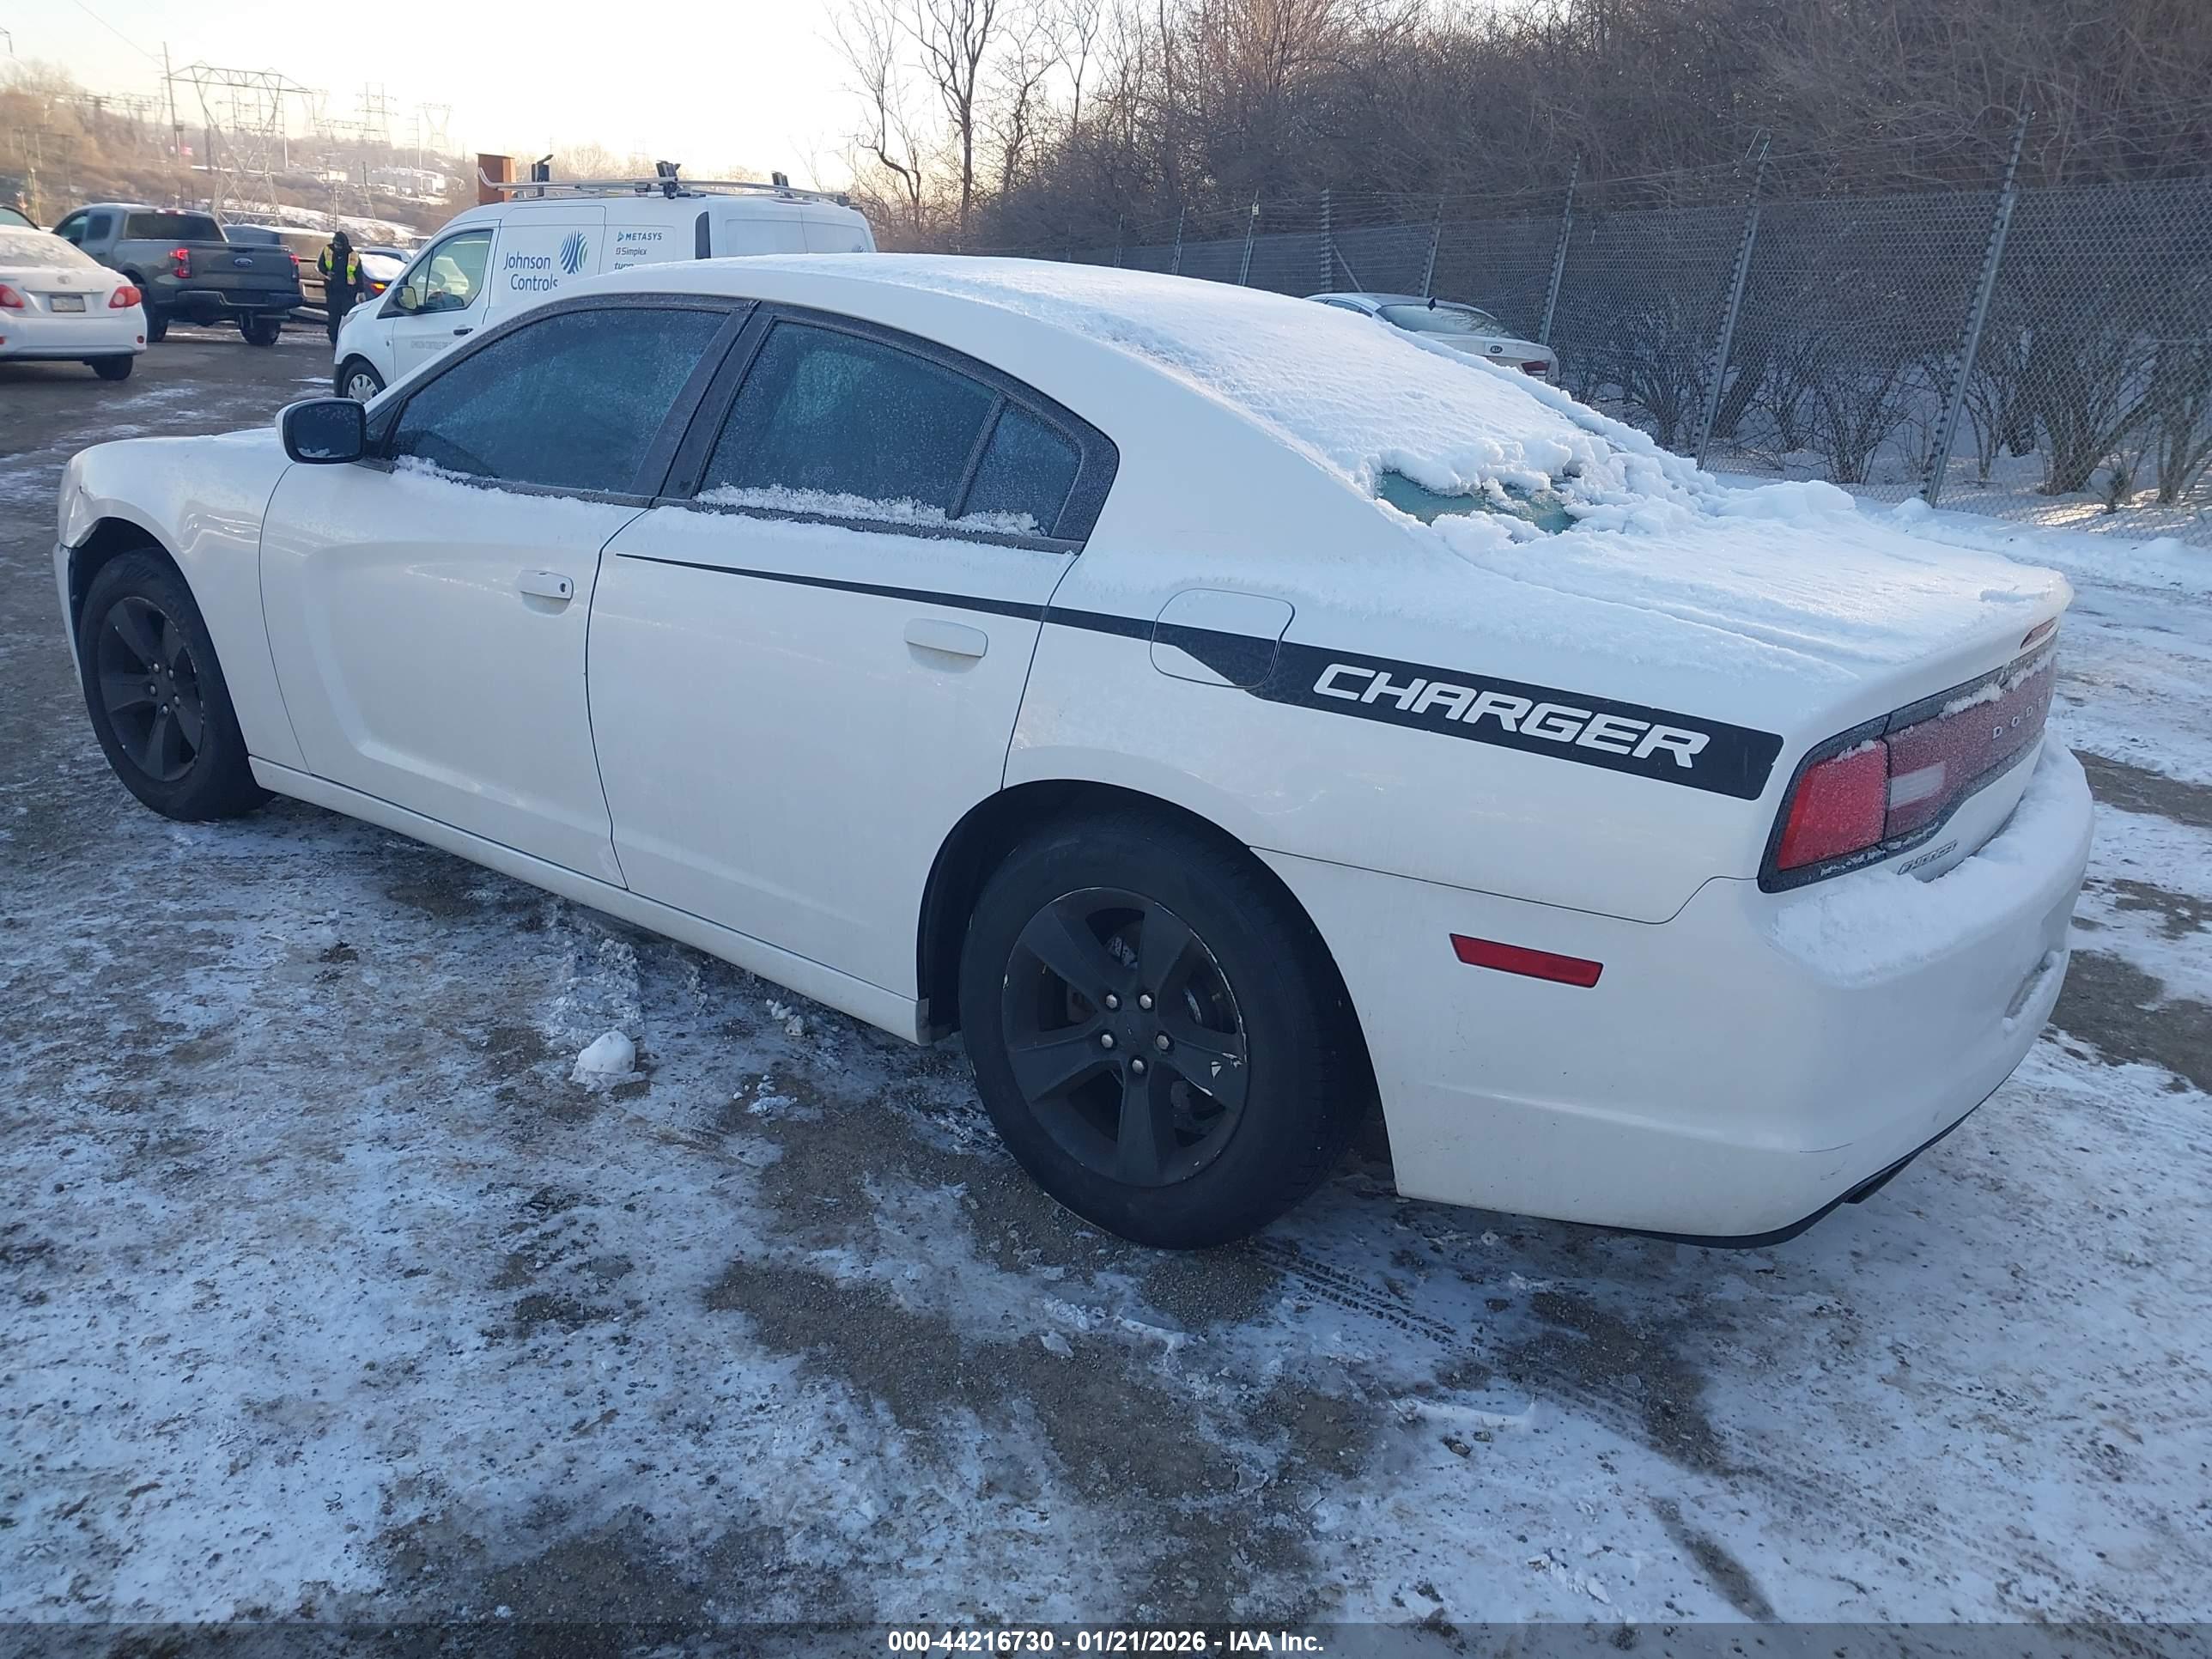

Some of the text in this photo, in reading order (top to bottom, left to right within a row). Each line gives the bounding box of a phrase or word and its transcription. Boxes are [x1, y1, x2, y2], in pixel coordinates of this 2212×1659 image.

[625, 232, 663, 241] METASYS
[503, 251, 550, 270] Johnson
[621, 246, 647, 258] Simplex
[510, 273, 558, 292] Controls
[1312, 663, 1711, 769] CHARGER
